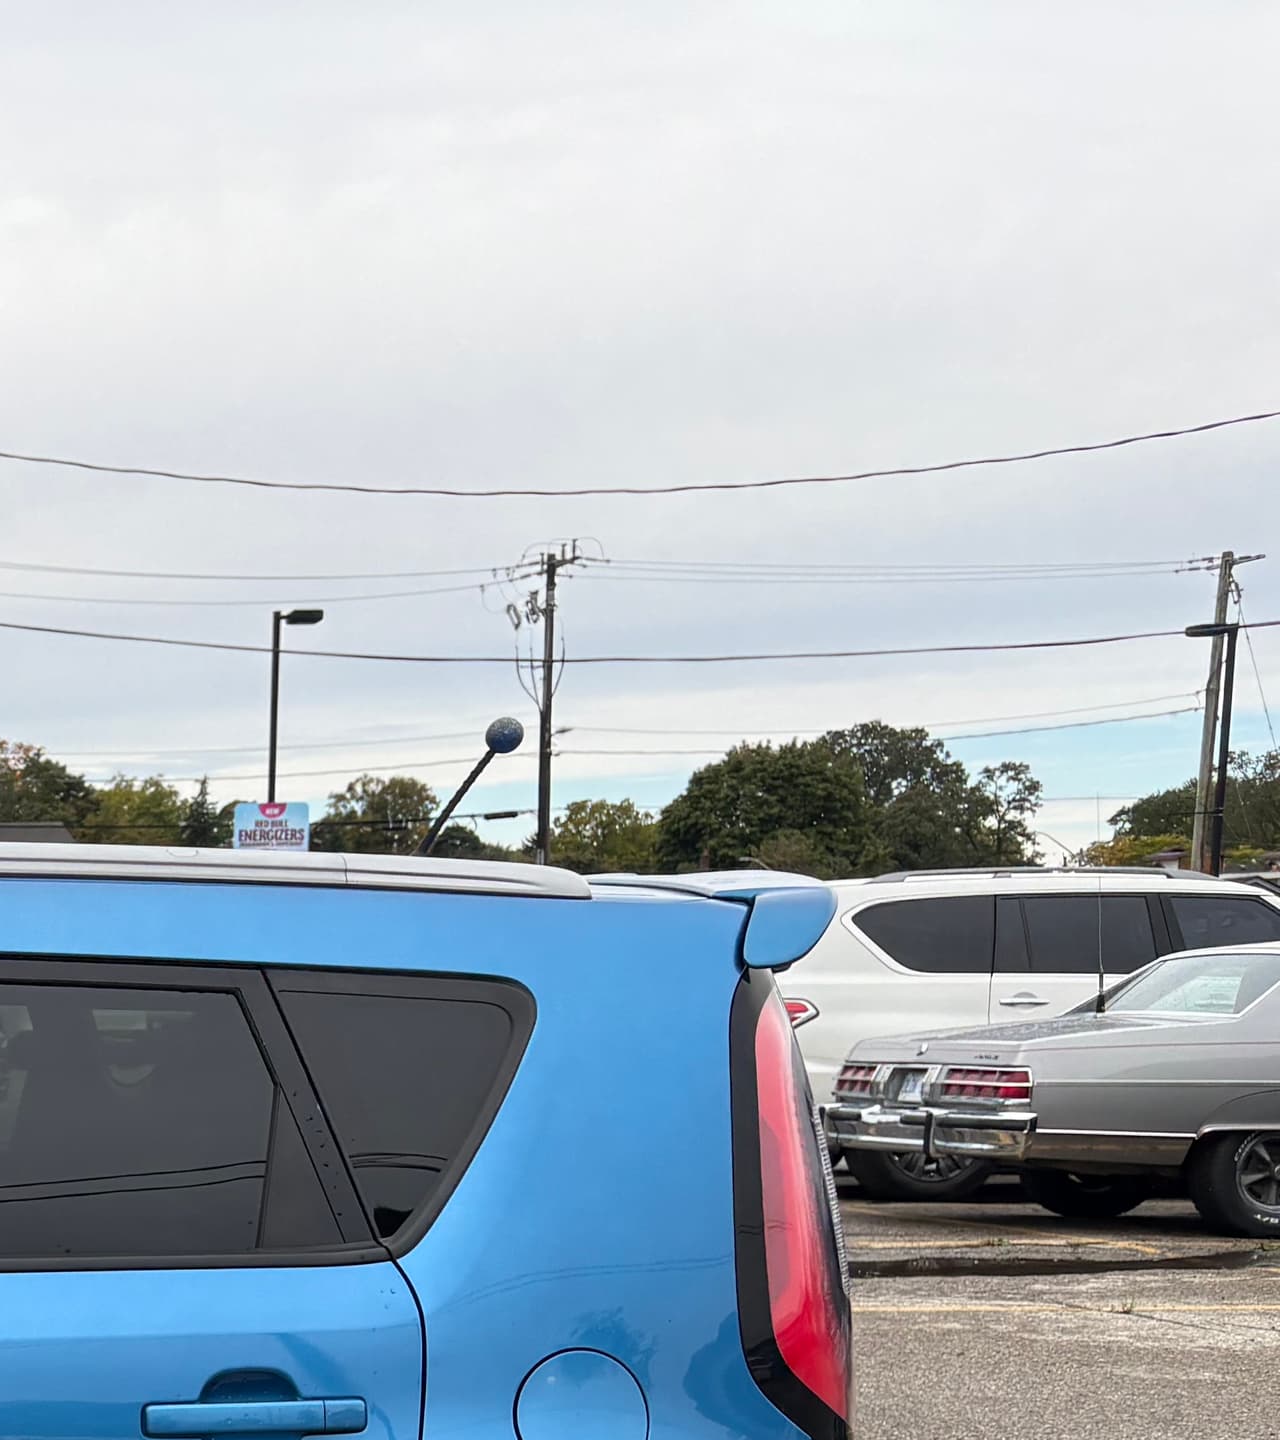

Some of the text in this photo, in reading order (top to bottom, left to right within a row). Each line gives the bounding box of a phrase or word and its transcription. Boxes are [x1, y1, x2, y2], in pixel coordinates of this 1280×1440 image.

[255, 819, 288, 828] RED BULL
[239, 828, 305, 842] ENERGIZERS
